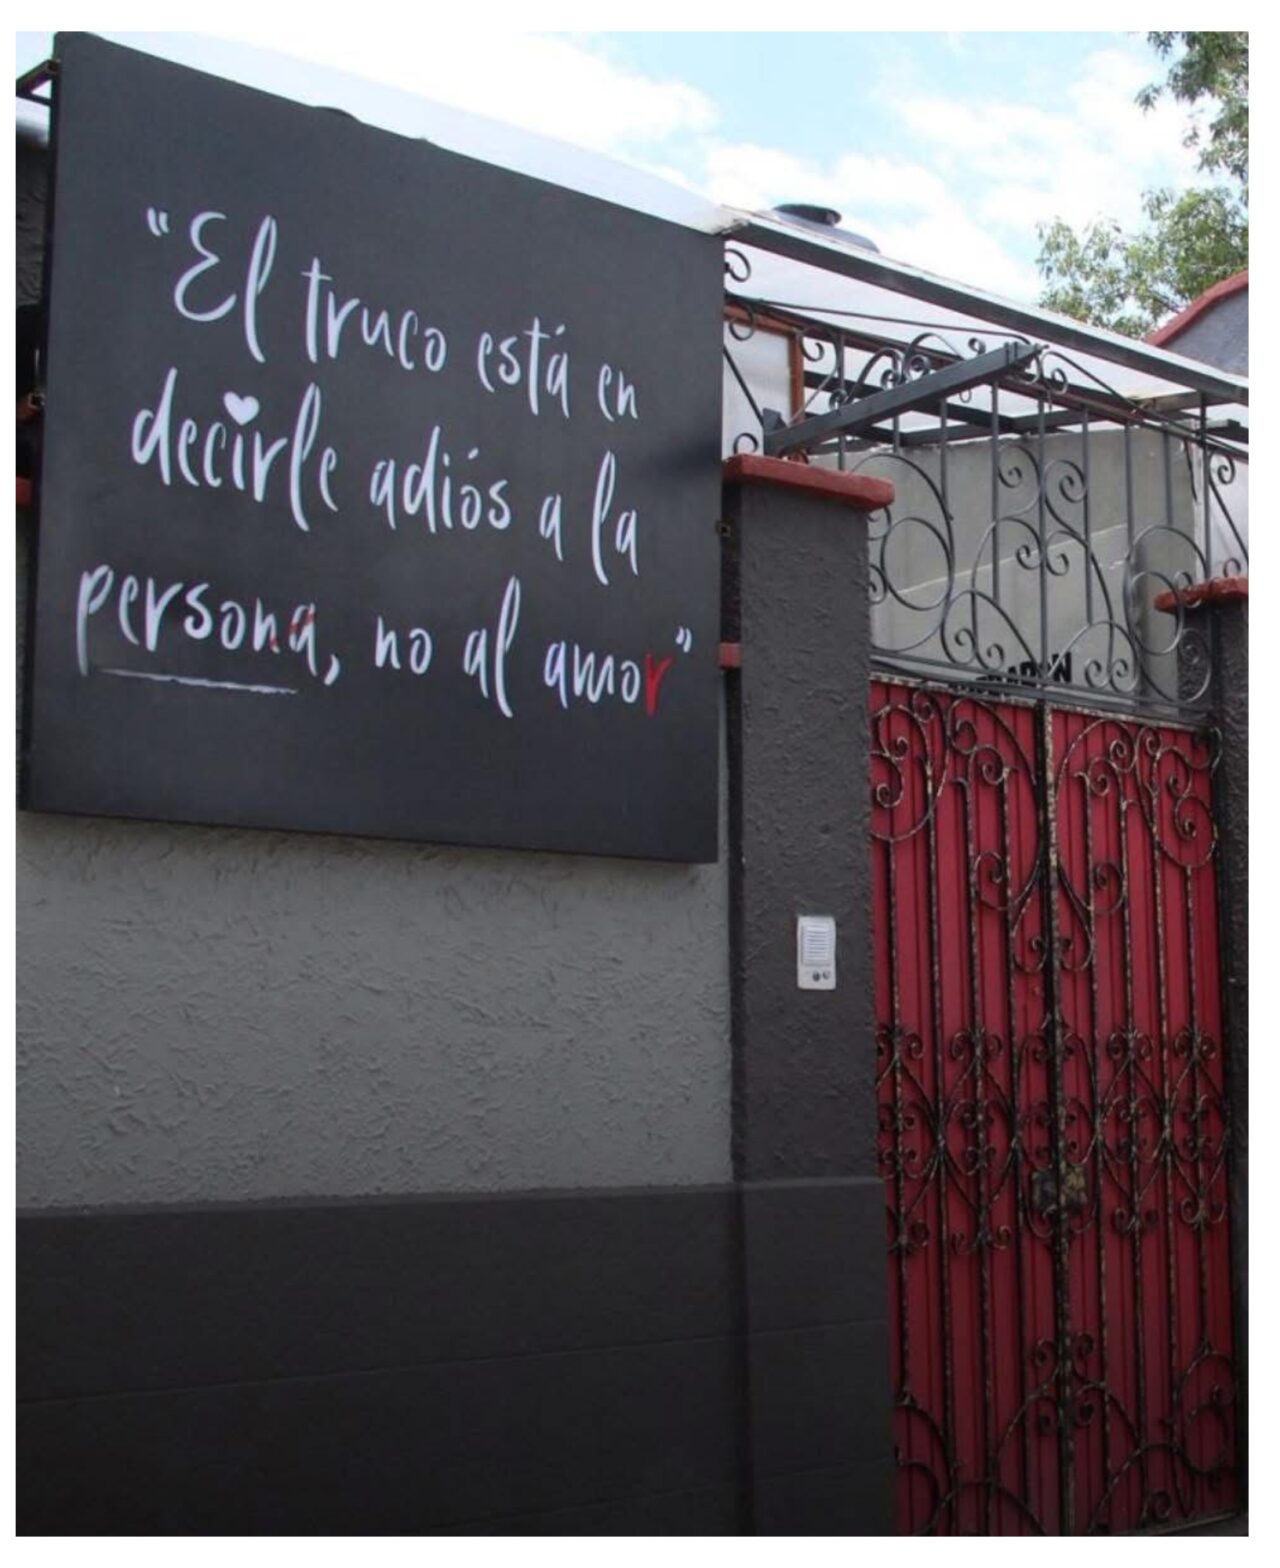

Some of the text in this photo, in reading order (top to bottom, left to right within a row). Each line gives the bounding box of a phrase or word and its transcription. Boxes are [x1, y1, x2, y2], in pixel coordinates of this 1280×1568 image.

[301, 257, 447, 371] truco
[477, 316, 570, 418] está
[598, 362, 639, 420] en
[131, 367, 639, 585] decirle adiós a la
[76, 564, 341, 686] persona,
[375, 615, 433, 674] no
[464, 576, 520, 717] al
